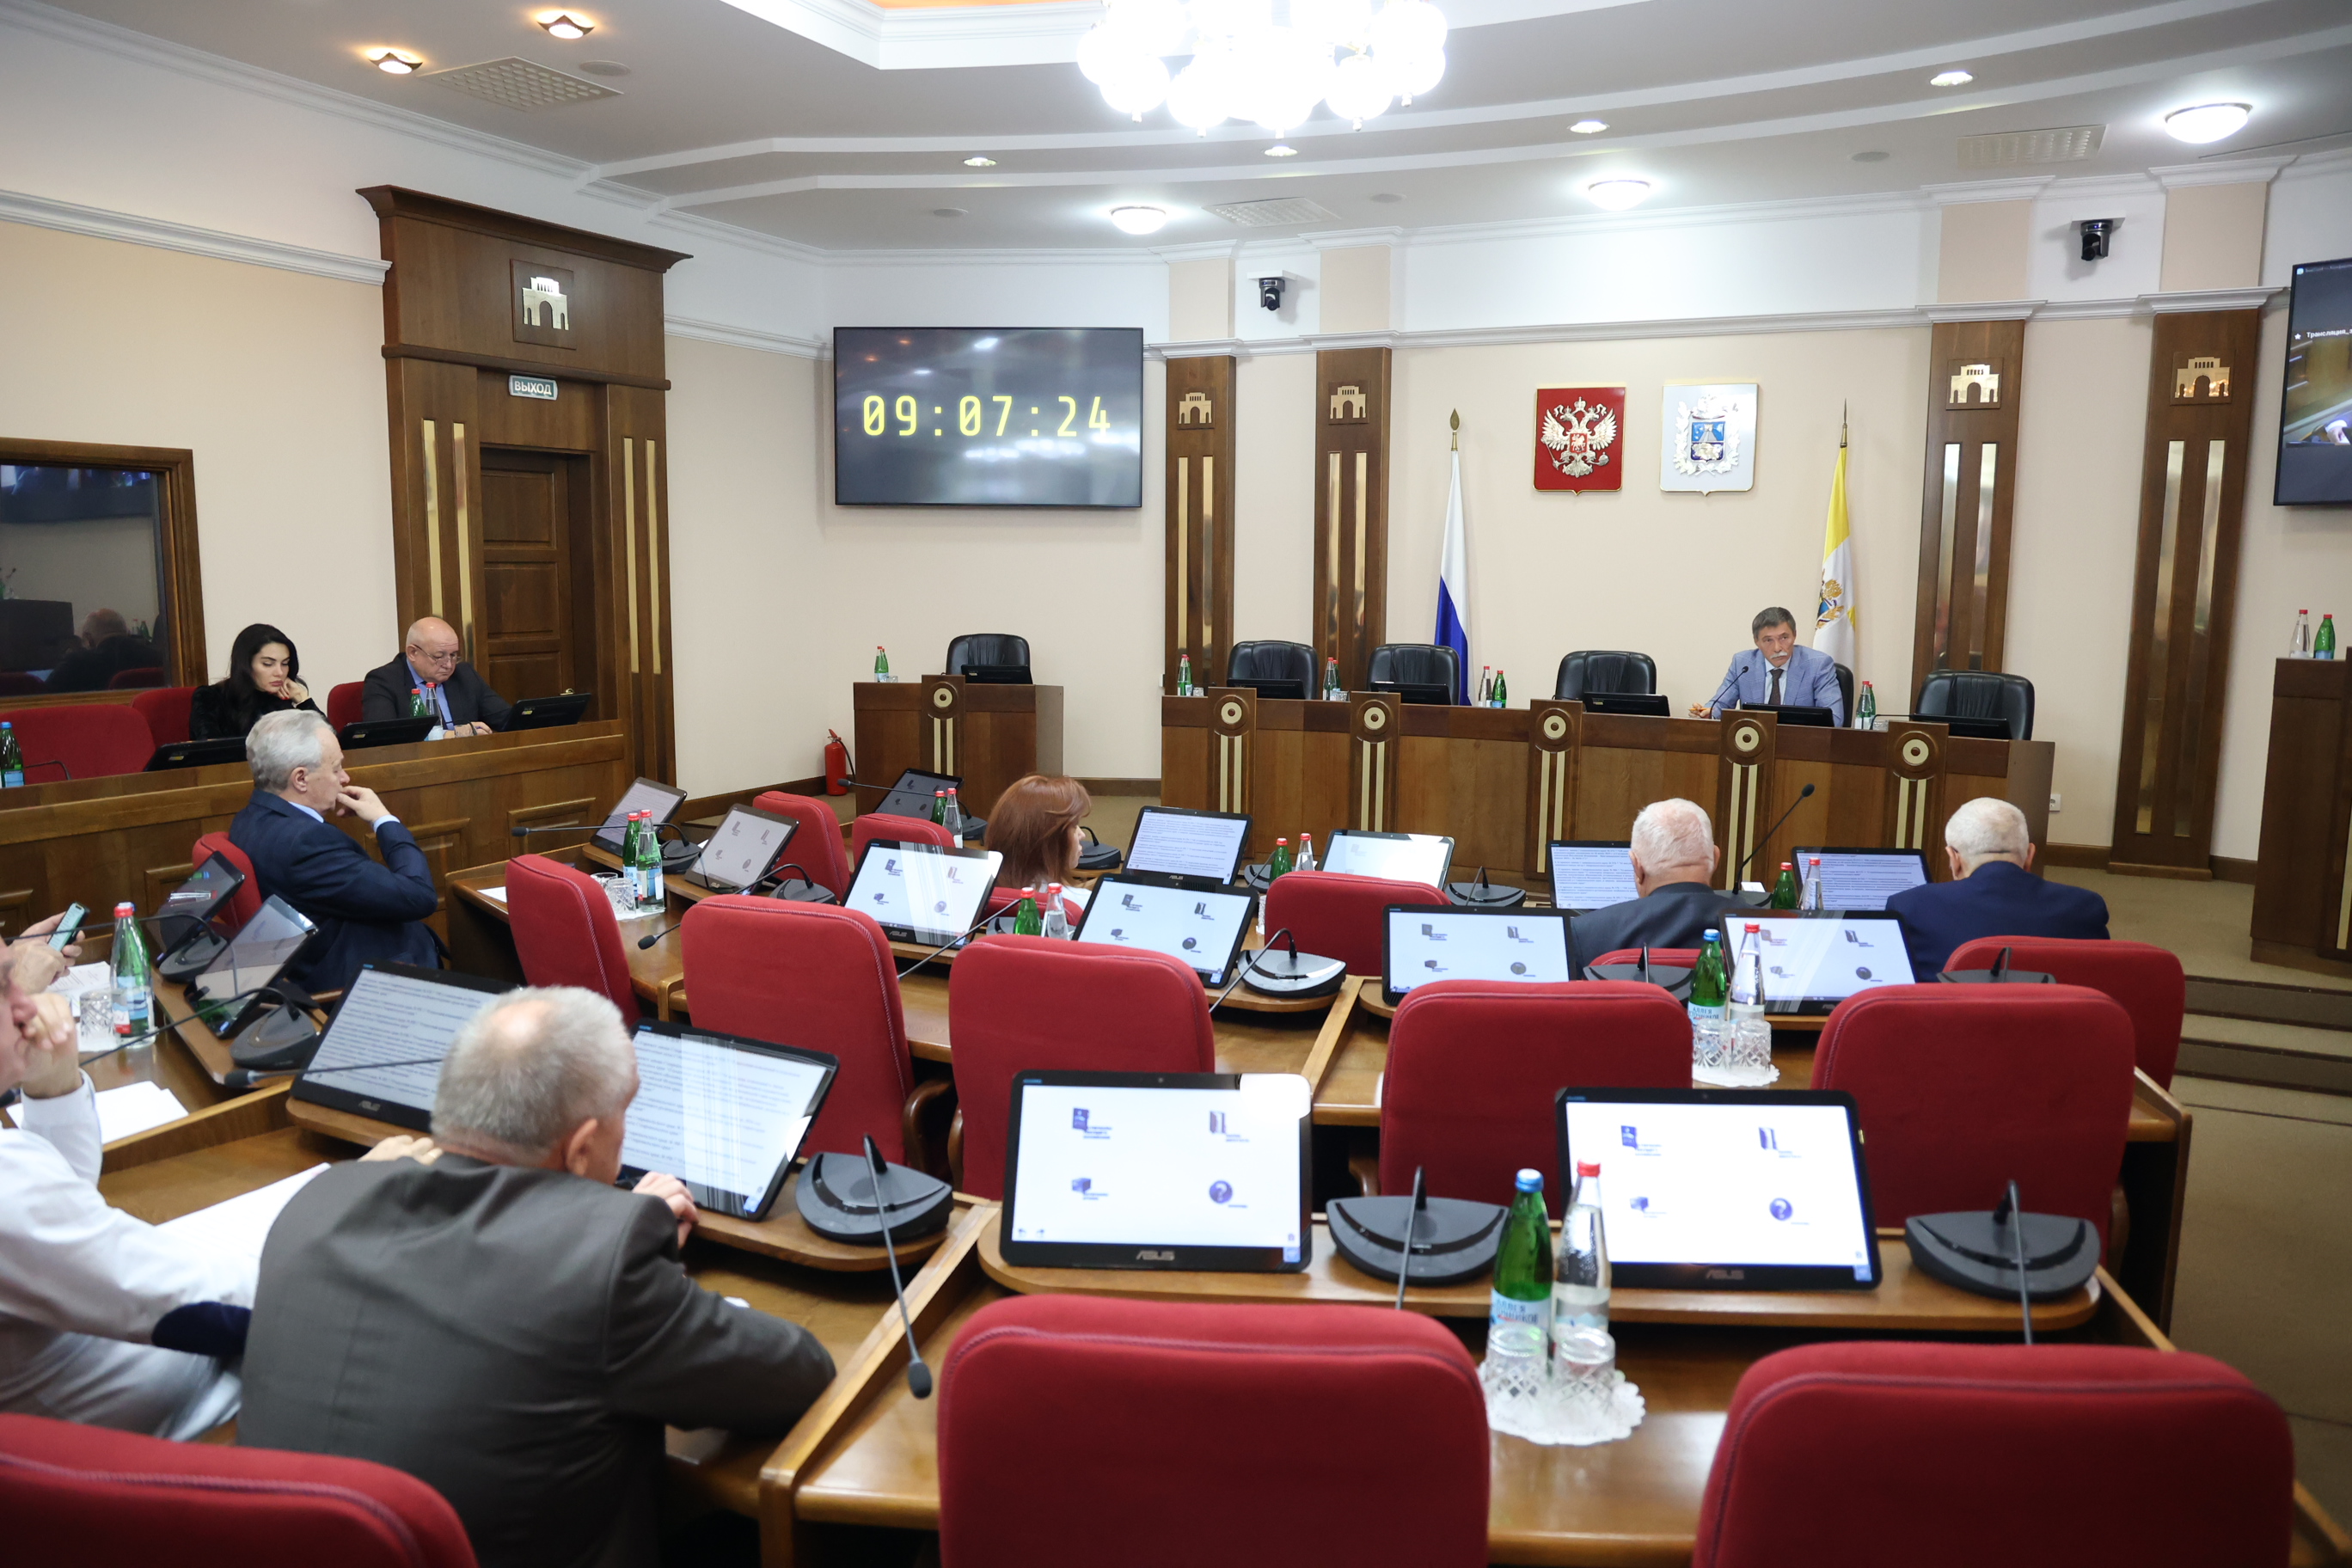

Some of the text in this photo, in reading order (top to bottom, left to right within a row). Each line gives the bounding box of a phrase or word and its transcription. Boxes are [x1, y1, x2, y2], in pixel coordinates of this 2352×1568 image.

[514, 380, 552, 395] ВЫХОД
[862, 395, 1111, 438] 09:07:24
[1136, 1250, 1175, 1261] ASUS
[1706, 1269, 1744, 1280] ASUS
